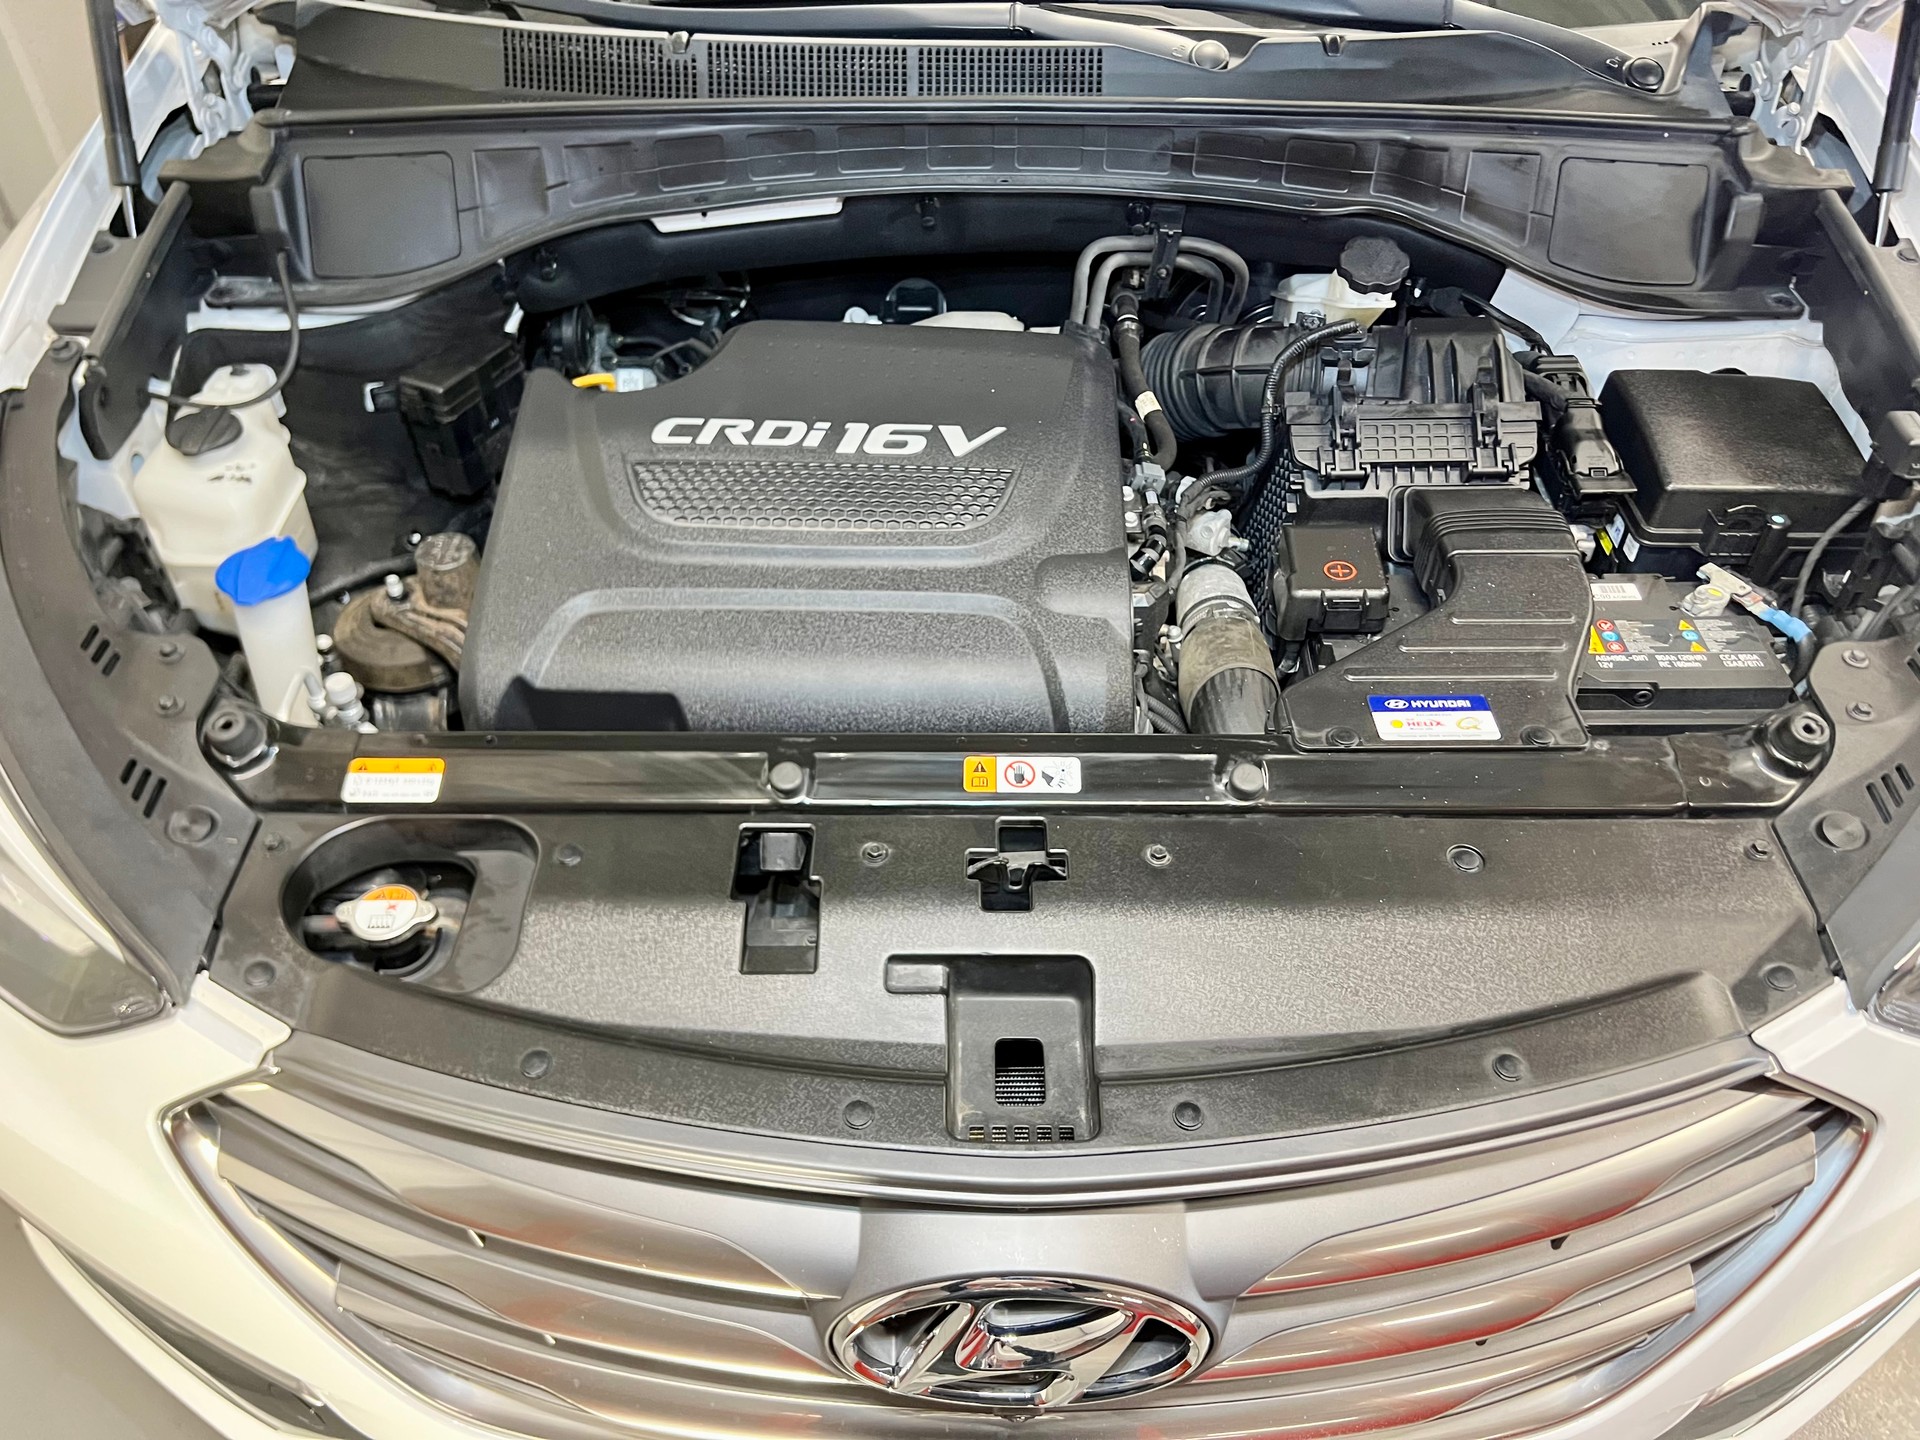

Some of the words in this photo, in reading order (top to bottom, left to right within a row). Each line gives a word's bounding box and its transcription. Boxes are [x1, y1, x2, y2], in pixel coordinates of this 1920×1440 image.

[650, 416, 832, 447] CRDi
[1597, 661, 1614, 669] 12V
[1411, 699, 1472, 709] HYUNDAI
[1406, 719, 1446, 727] HELIX
